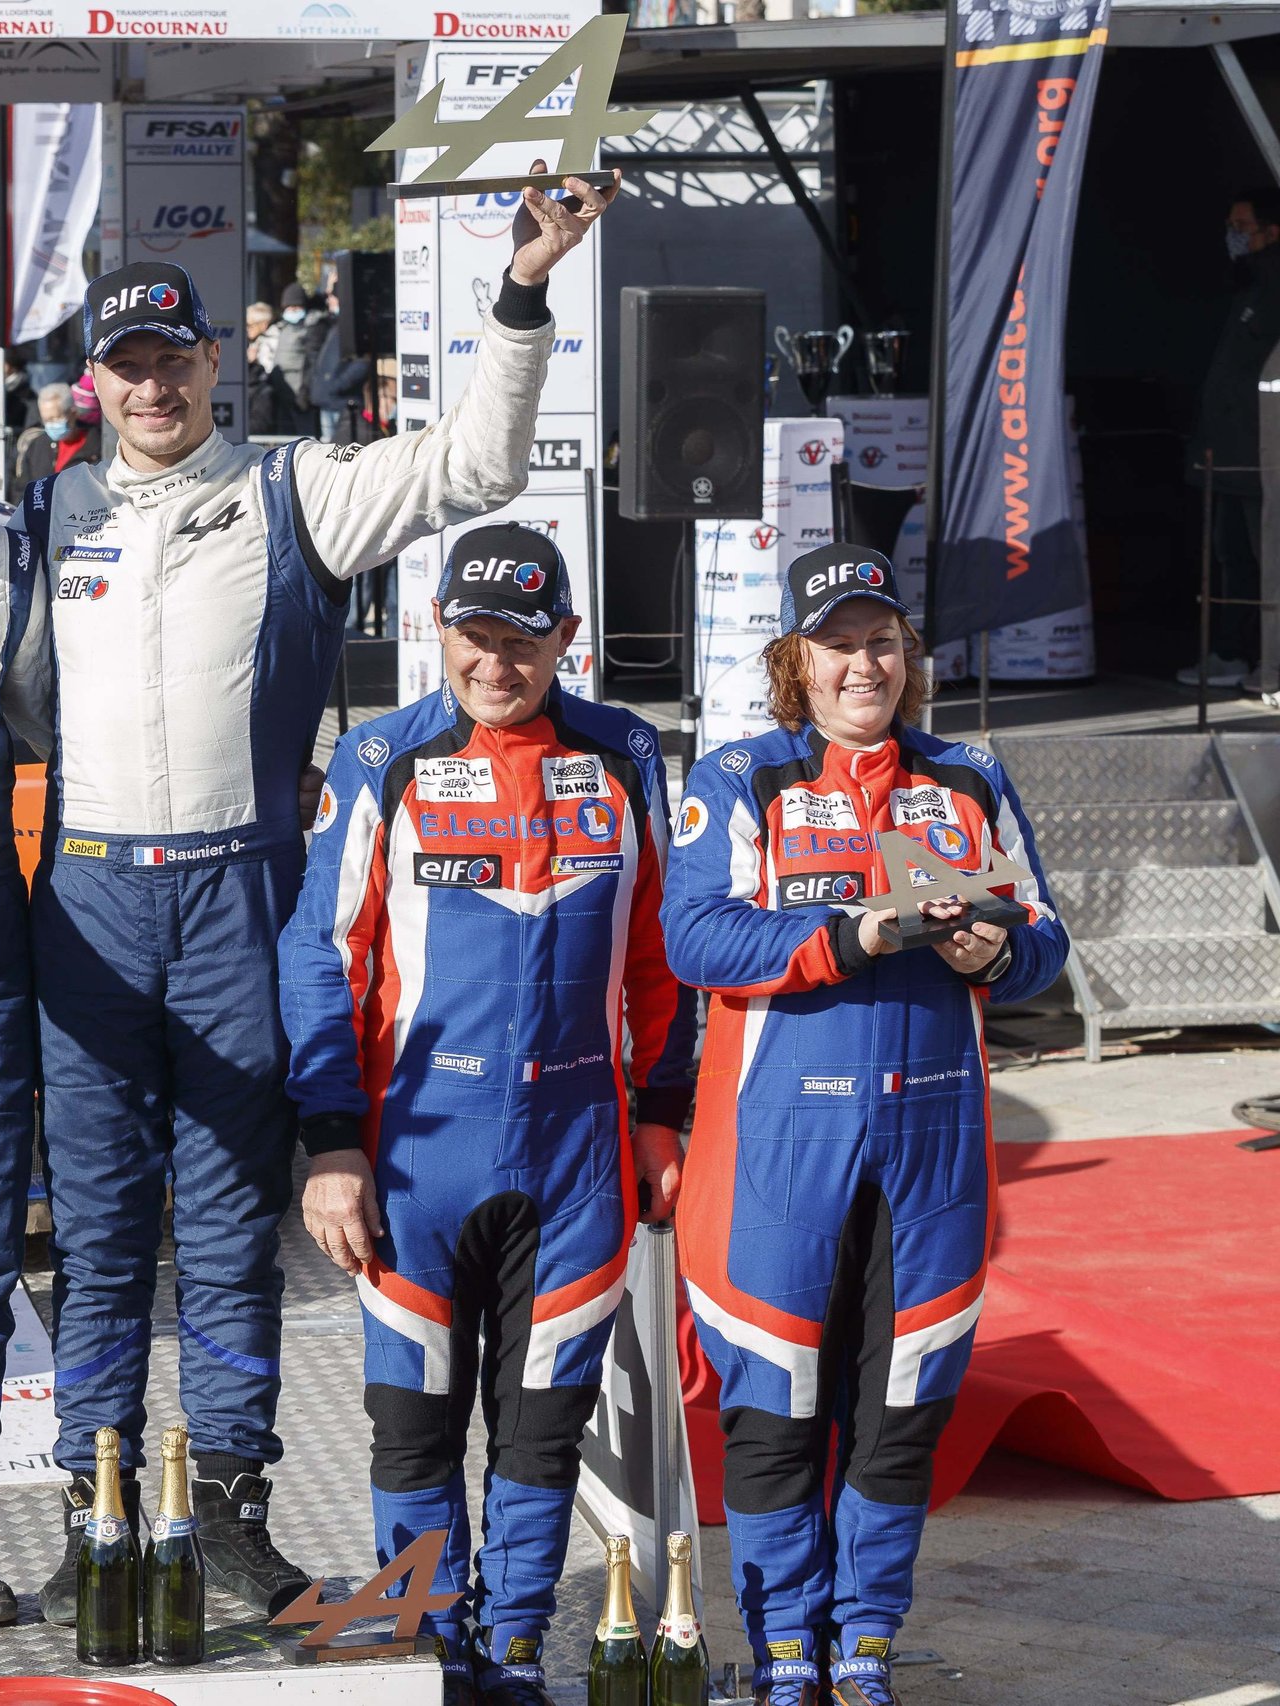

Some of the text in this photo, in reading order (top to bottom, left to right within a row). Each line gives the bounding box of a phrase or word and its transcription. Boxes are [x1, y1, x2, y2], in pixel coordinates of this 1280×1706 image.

[88, 10, 228, 35] DUCOURNAU
[433, 13, 570, 37] DUCOURNAU
[146, 121, 229, 138] FFSA
[173, 143, 234, 158] RALLYE
[139, 466, 208, 500] ALPINE
[67, 512, 118, 522] ALPINE
[77, 533, 104, 541] RALLY
[70, 551, 115, 559] MICHELIN
[57, 576, 91, 599] elf
[419, 768, 490, 778] ALPINE
[439, 790, 473, 798] RALLY
[555, 782, 600, 795] BAHCO
[805, 816, 837, 827] RALLY
[903, 807, 947, 821] BAHCO
[67, 840, 105, 855] Sabelt
[166, 844, 226, 862] Saunier
[419, 859, 469, 882] elf
[574, 859, 620, 869] MICHELIN
[785, 877, 832, 901] elf
[904, 1068, 969, 1085] Alexandra Robin
[500, 1667, 537, 1680] Jean-Luc
[760, 1664, 819, 1681] Alexandra
